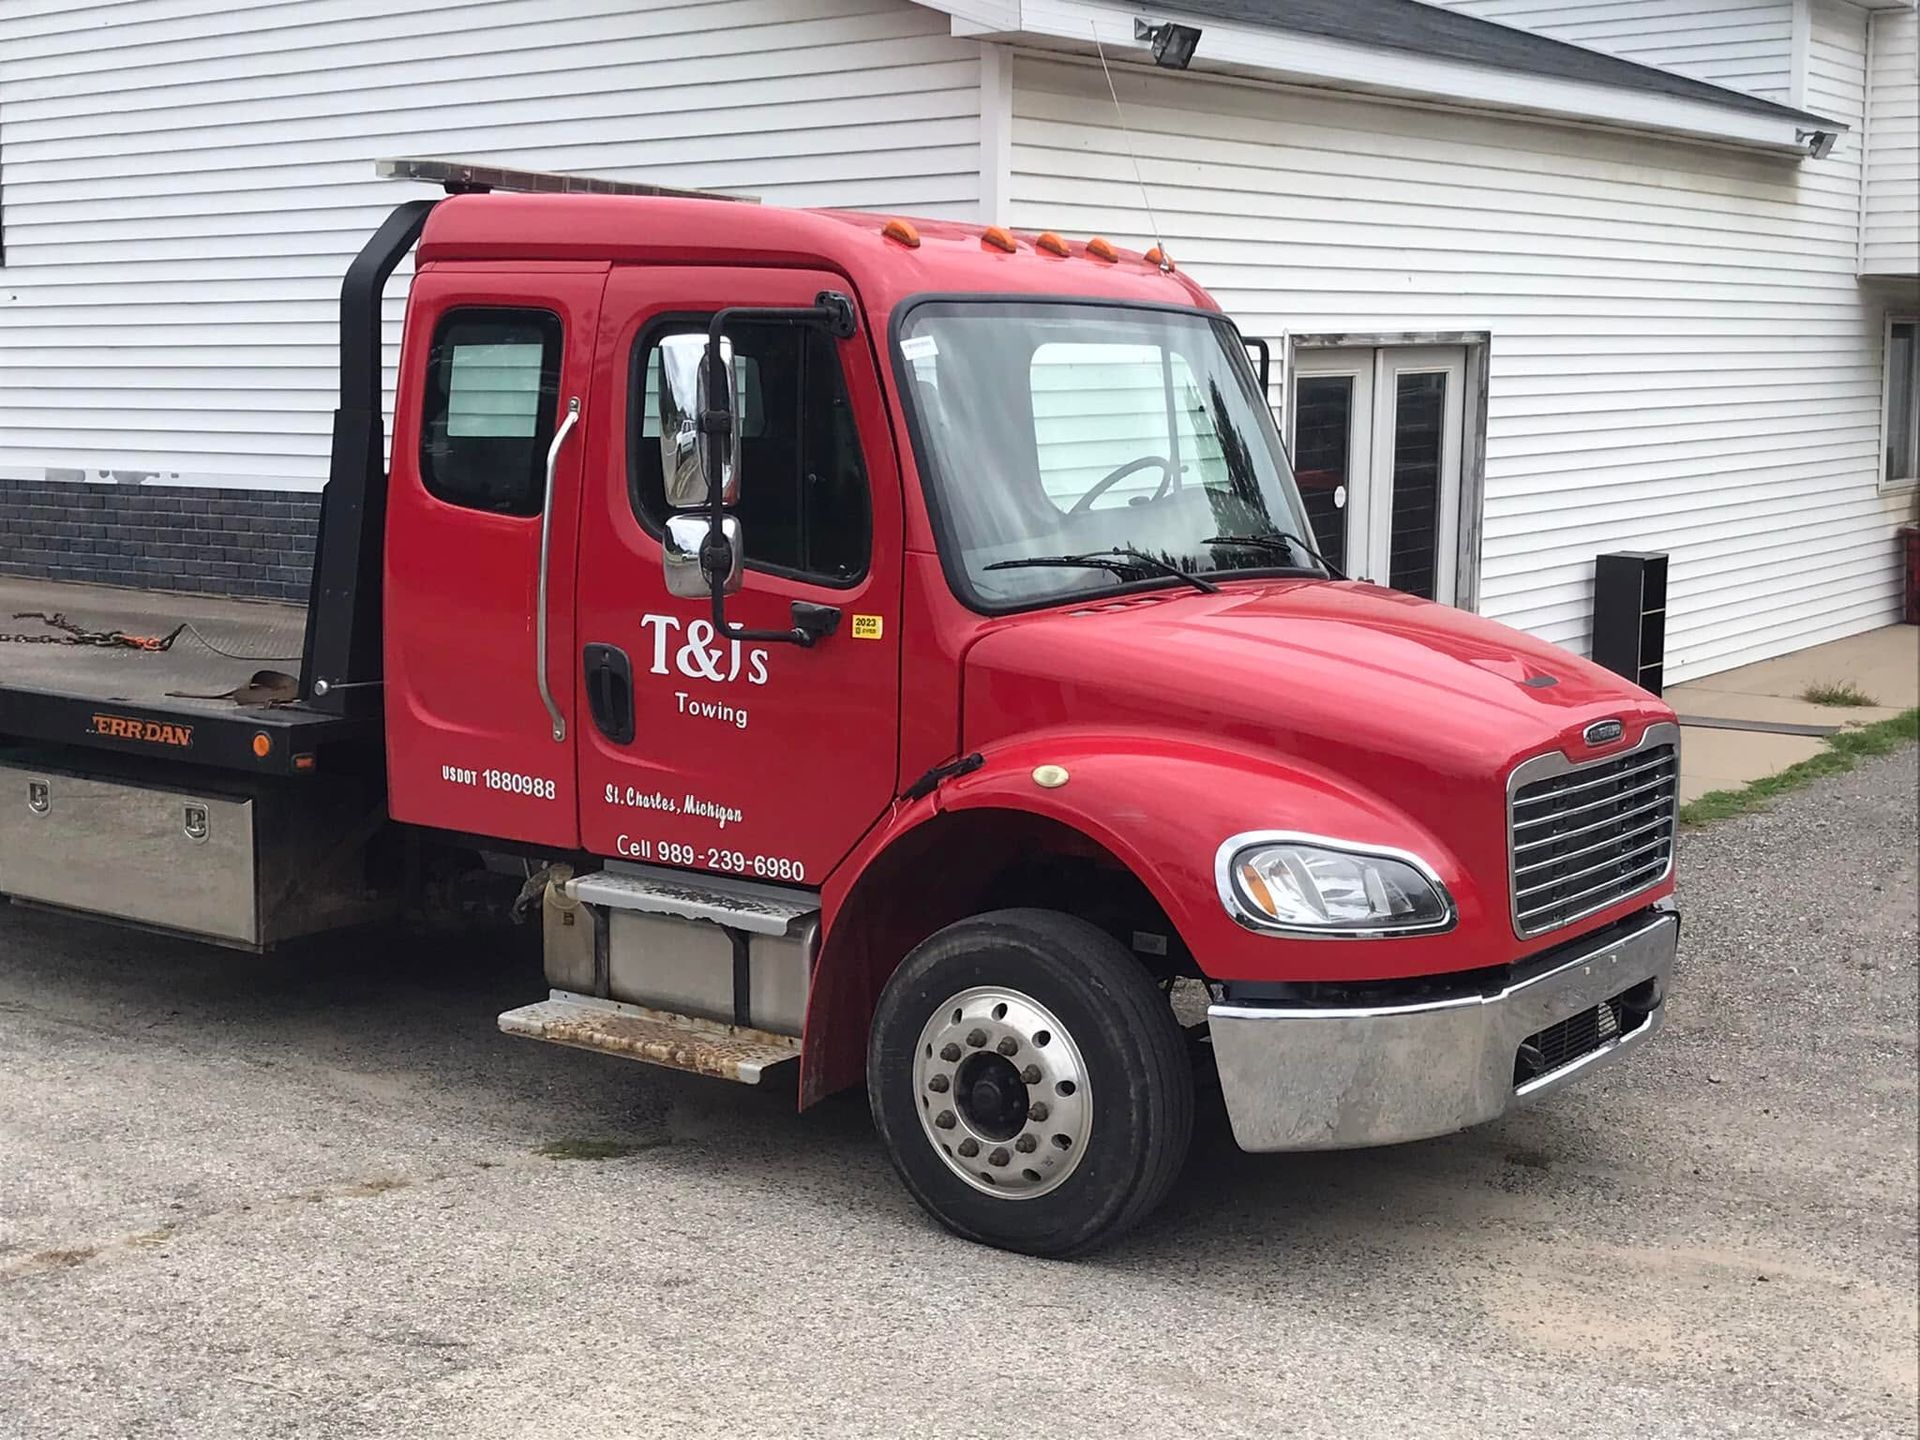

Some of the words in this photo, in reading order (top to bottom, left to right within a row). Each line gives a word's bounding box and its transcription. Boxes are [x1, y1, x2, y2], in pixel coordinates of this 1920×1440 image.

[855, 617, 877, 627] 2023
[675, 692, 747, 728] Towing
[442, 765, 477, 786] USDOT
[482, 769, 555, 800] 1880988
[605, 783, 624, 804] St.
[626, 787, 680, 814] Charles,
[683, 794, 742, 828] Michigan
[617, 835, 650, 858] Cell
[658, 841, 804, 881] 989-239-6980
